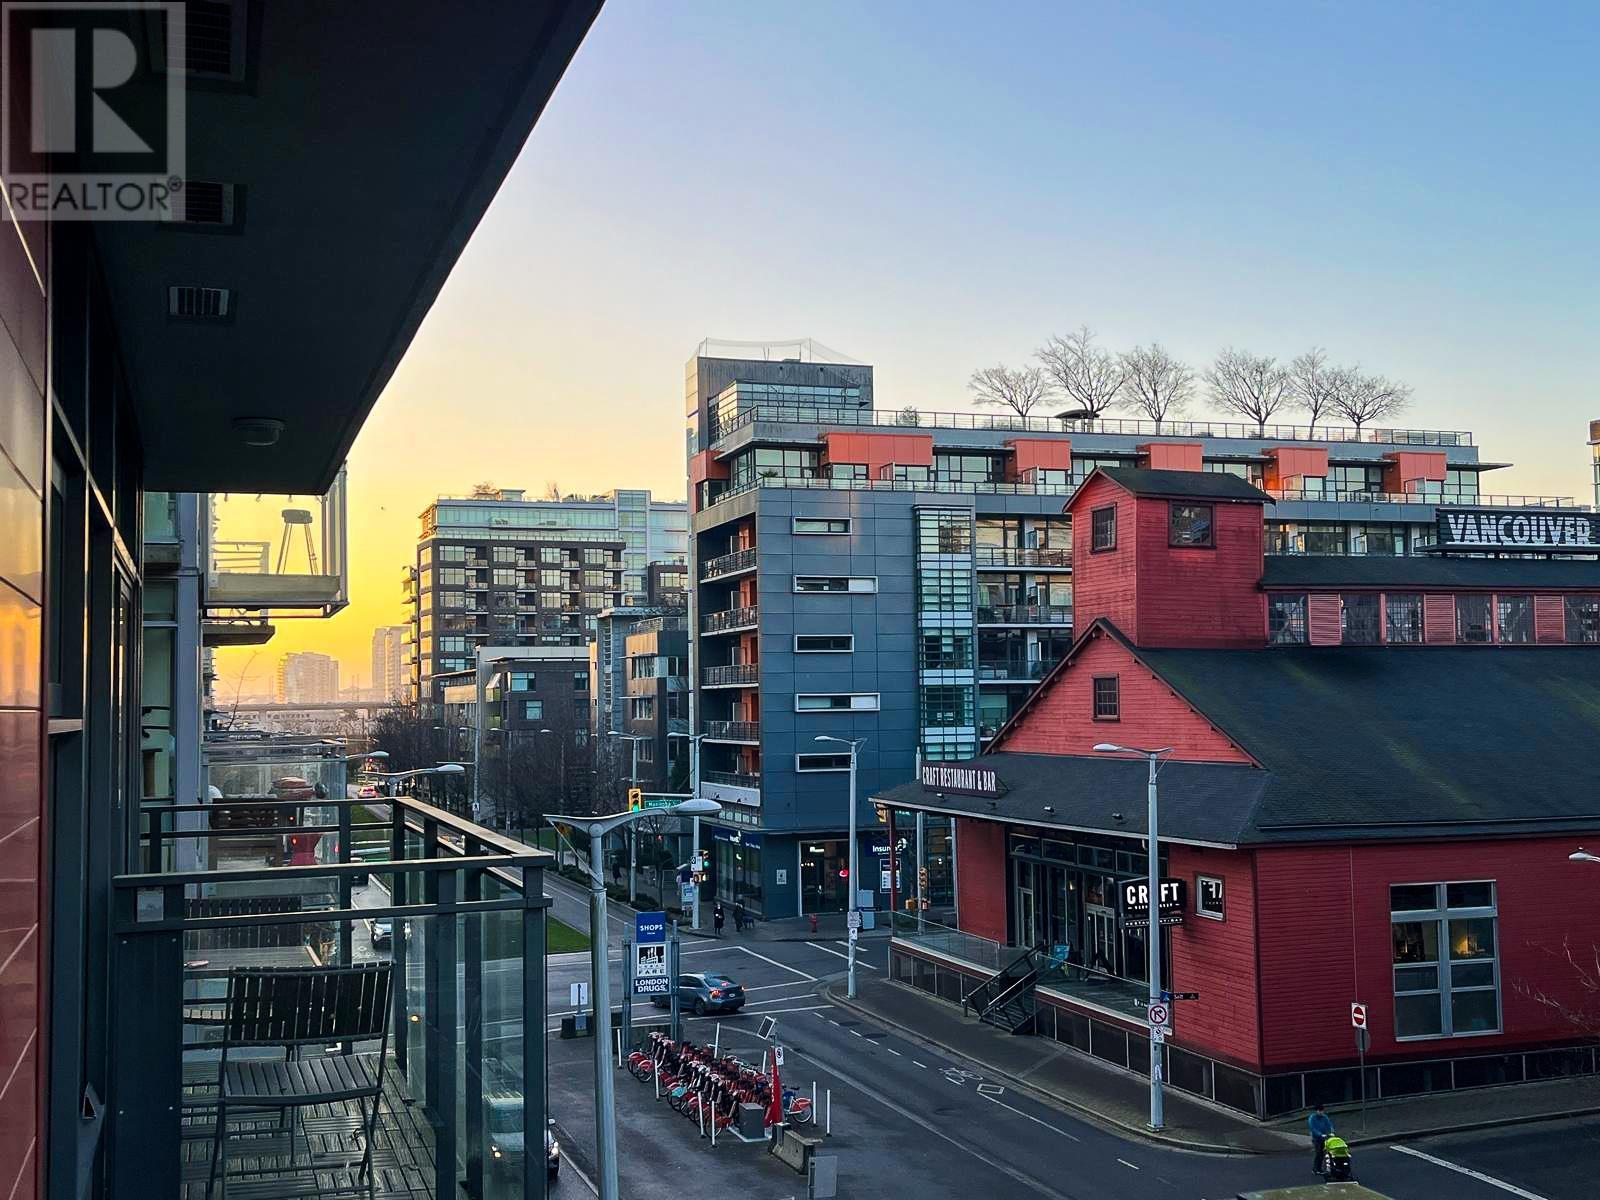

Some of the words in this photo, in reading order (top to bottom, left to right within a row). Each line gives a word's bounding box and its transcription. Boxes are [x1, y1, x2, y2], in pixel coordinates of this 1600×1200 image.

[1447, 514, 1592, 545] VANCOUVER
[922, 766, 940, 787] CRAFT
[940, 767, 976, 790] RESTAURANT
[977, 770, 983, 791] &
[983, 770, 997, 792] BAR
[1126, 883, 1179, 905] CRFT
[639, 924, 664, 932] SHOPS
[635, 978, 669, 986] LONDON
